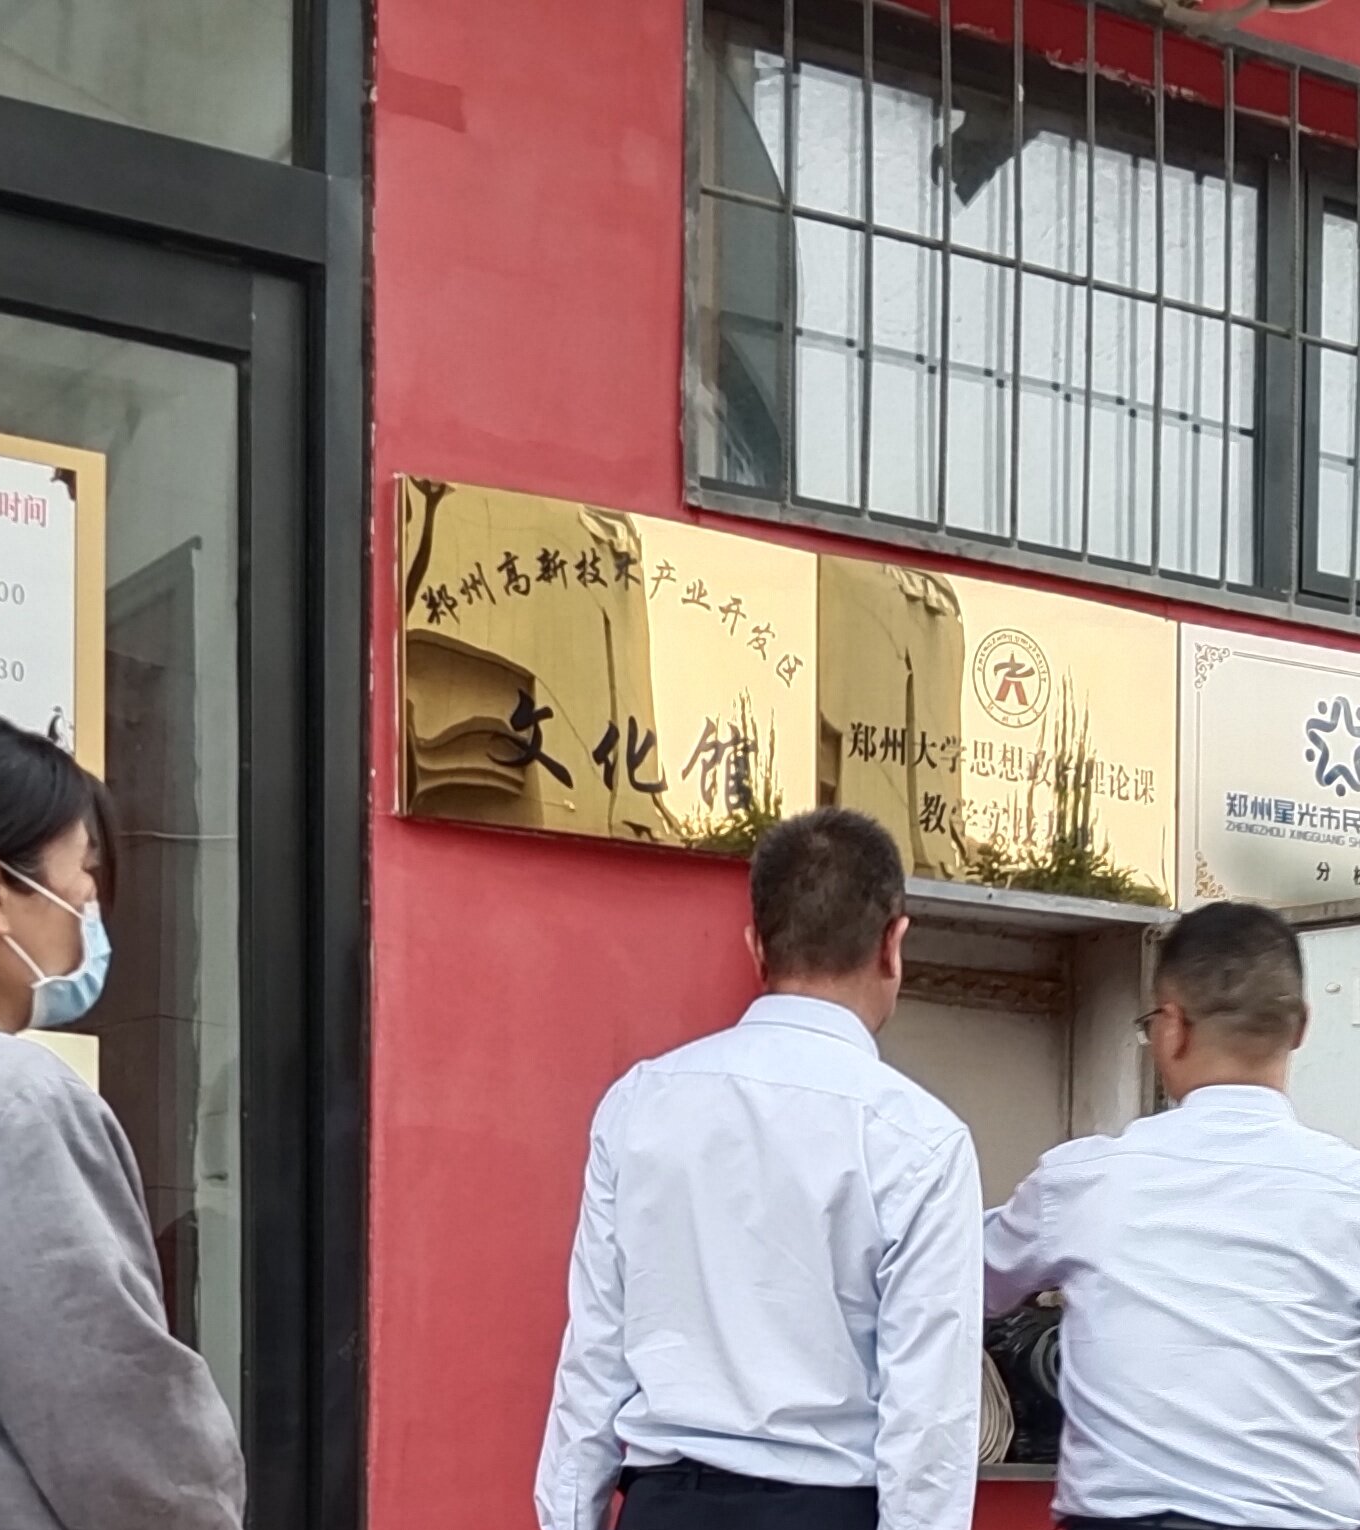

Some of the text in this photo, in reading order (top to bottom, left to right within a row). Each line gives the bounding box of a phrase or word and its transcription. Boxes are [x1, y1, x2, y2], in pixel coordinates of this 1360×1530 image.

[421, 548, 803, 687] 郑州高新技术产业开发区
[487, 688, 758, 815] 文化馆
[1225, 820, 1286, 838] ZHENGZHOU
[1289, 829, 1345, 846] XINGGUANG
